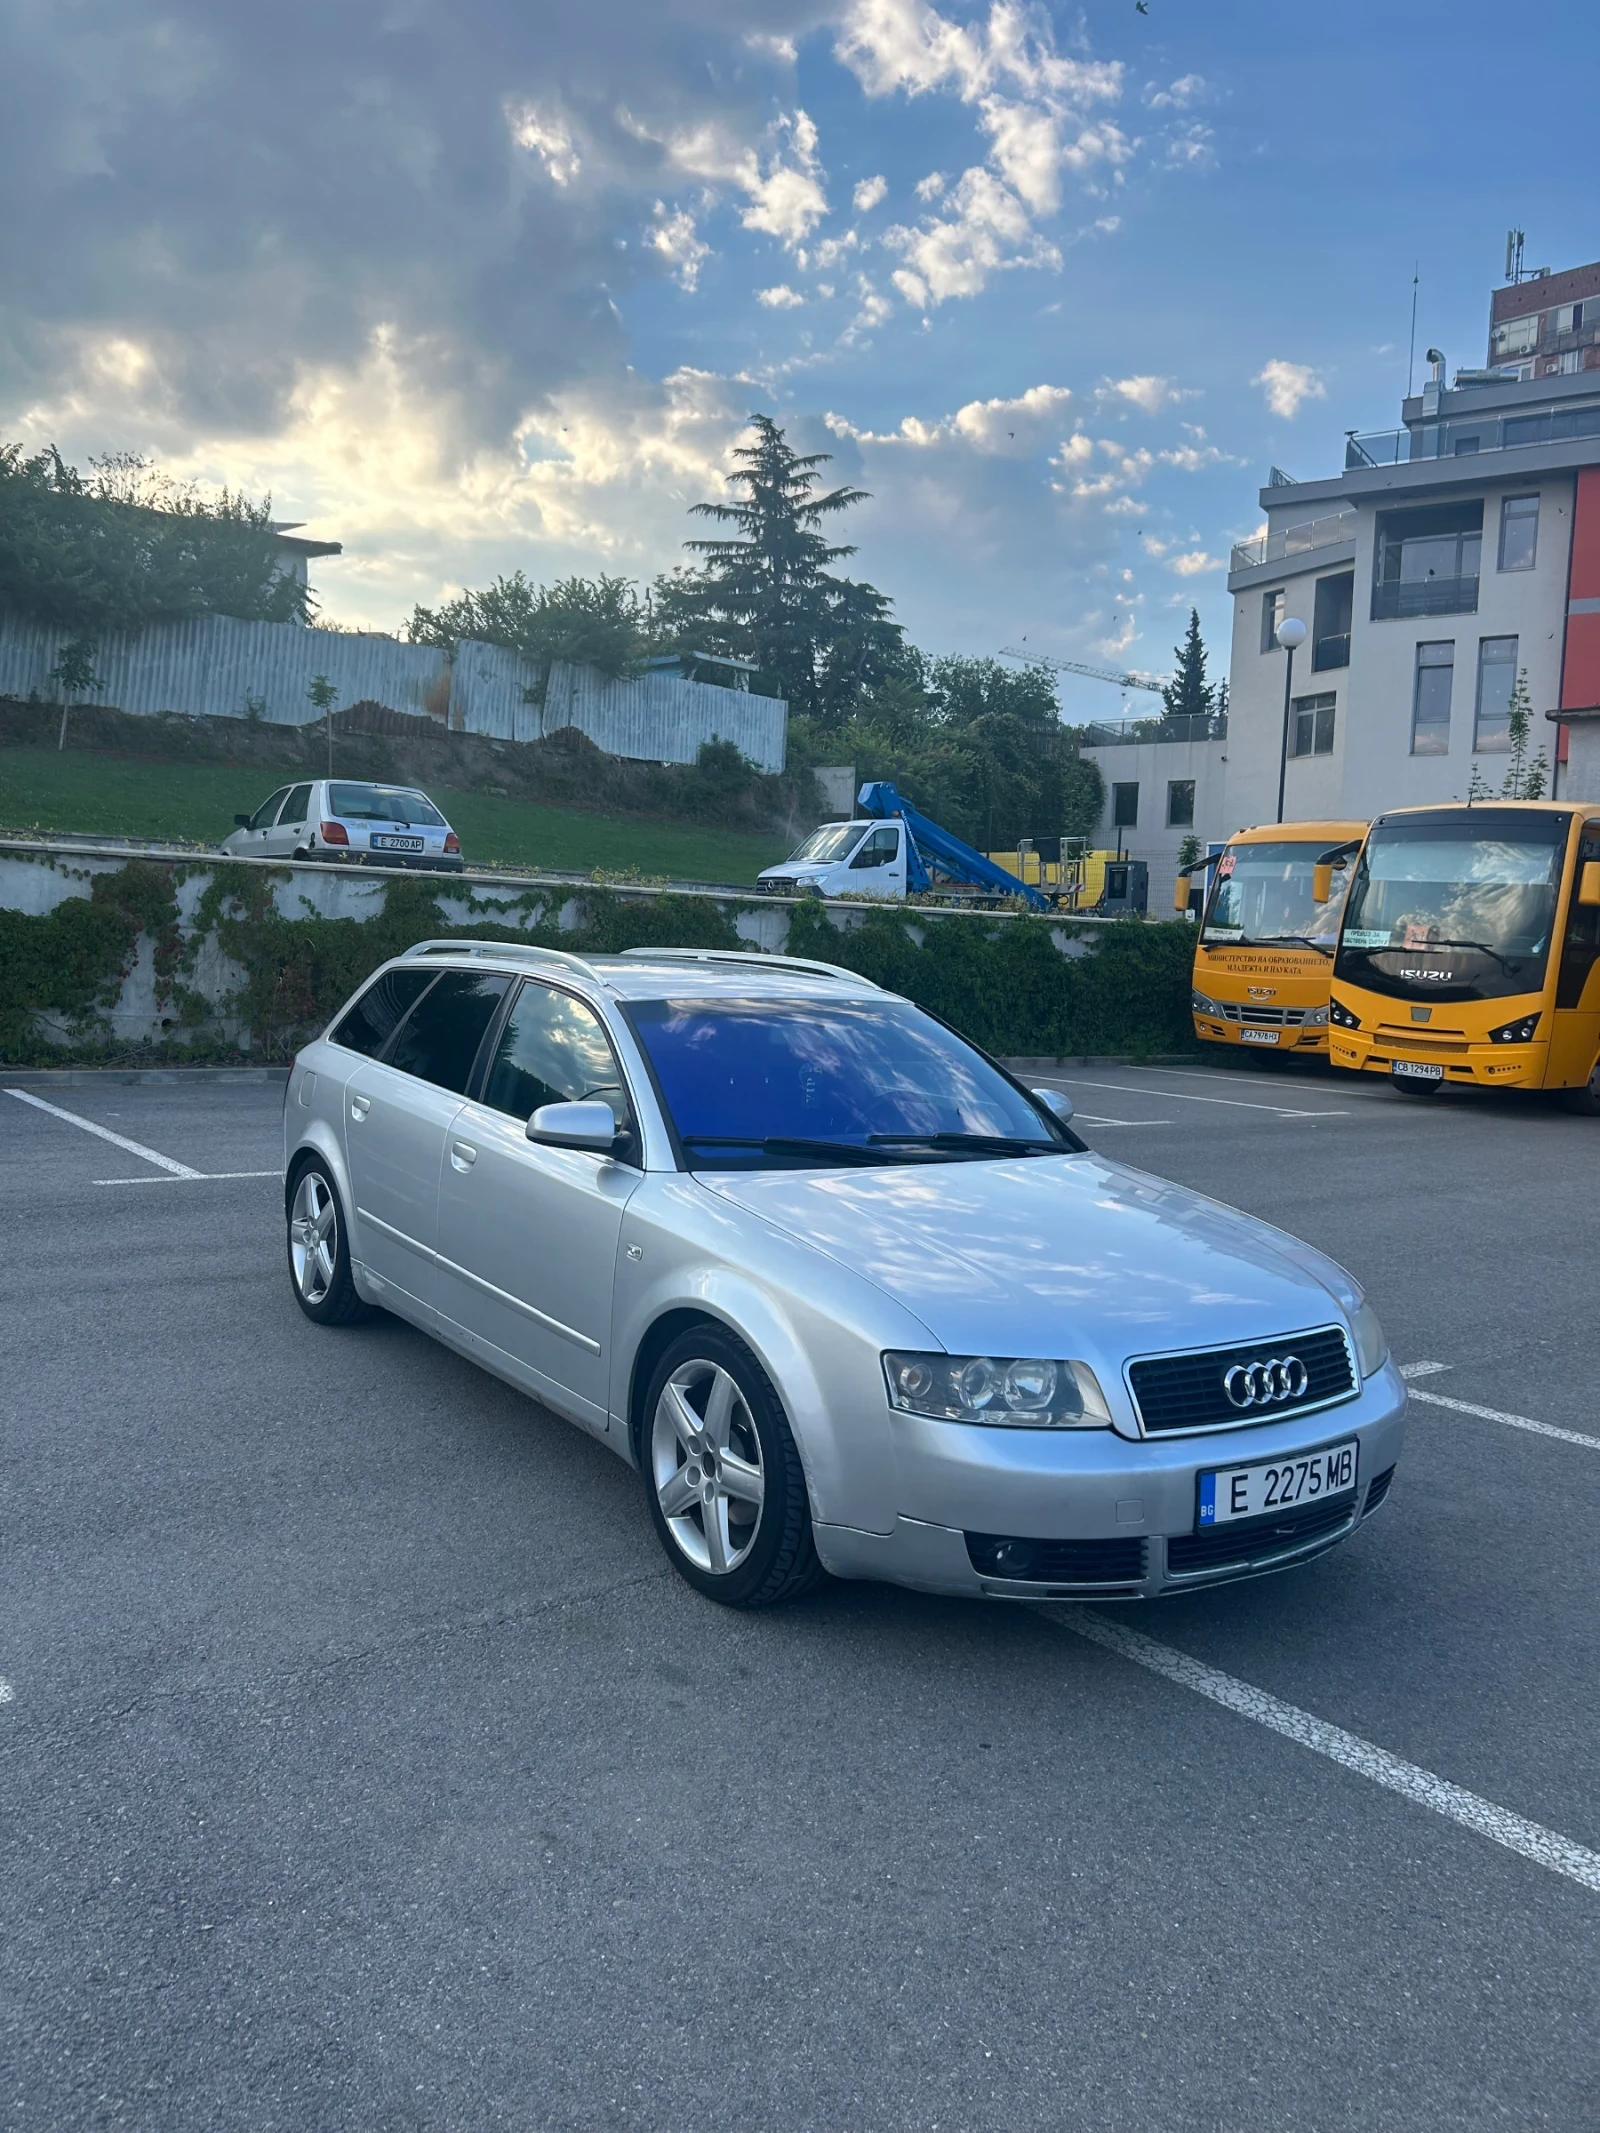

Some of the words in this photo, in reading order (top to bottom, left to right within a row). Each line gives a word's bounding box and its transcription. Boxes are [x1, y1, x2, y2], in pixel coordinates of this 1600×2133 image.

[381, 837, 387, 846] E
[390, 838, 410, 848] 2700
[411, 840, 421, 849] AP
[1207, 954, 1257, 963] МИНИСТЕРСТВО
[1258, 955, 1267, 963] НА
[1227, 964, 1262, 973] МЛАДЕЖТА
[1263, 965, 1270, 973] И
[1270, 965, 1302, 974] НАУКАТА
[1400, 969, 1452, 981] ISUZU
[1247, 986, 1277, 996] ISUZU
[1397, 1062, 1409, 1072] CB
[1410, 1063, 1429, 1075] 1294
[1230, 1473, 1249, 1514] E
[1263, 1458, 1322, 1508] 2275
[1326, 1449, 1352, 1492] MB
[1200, 1504, 1214, 1518] BG
